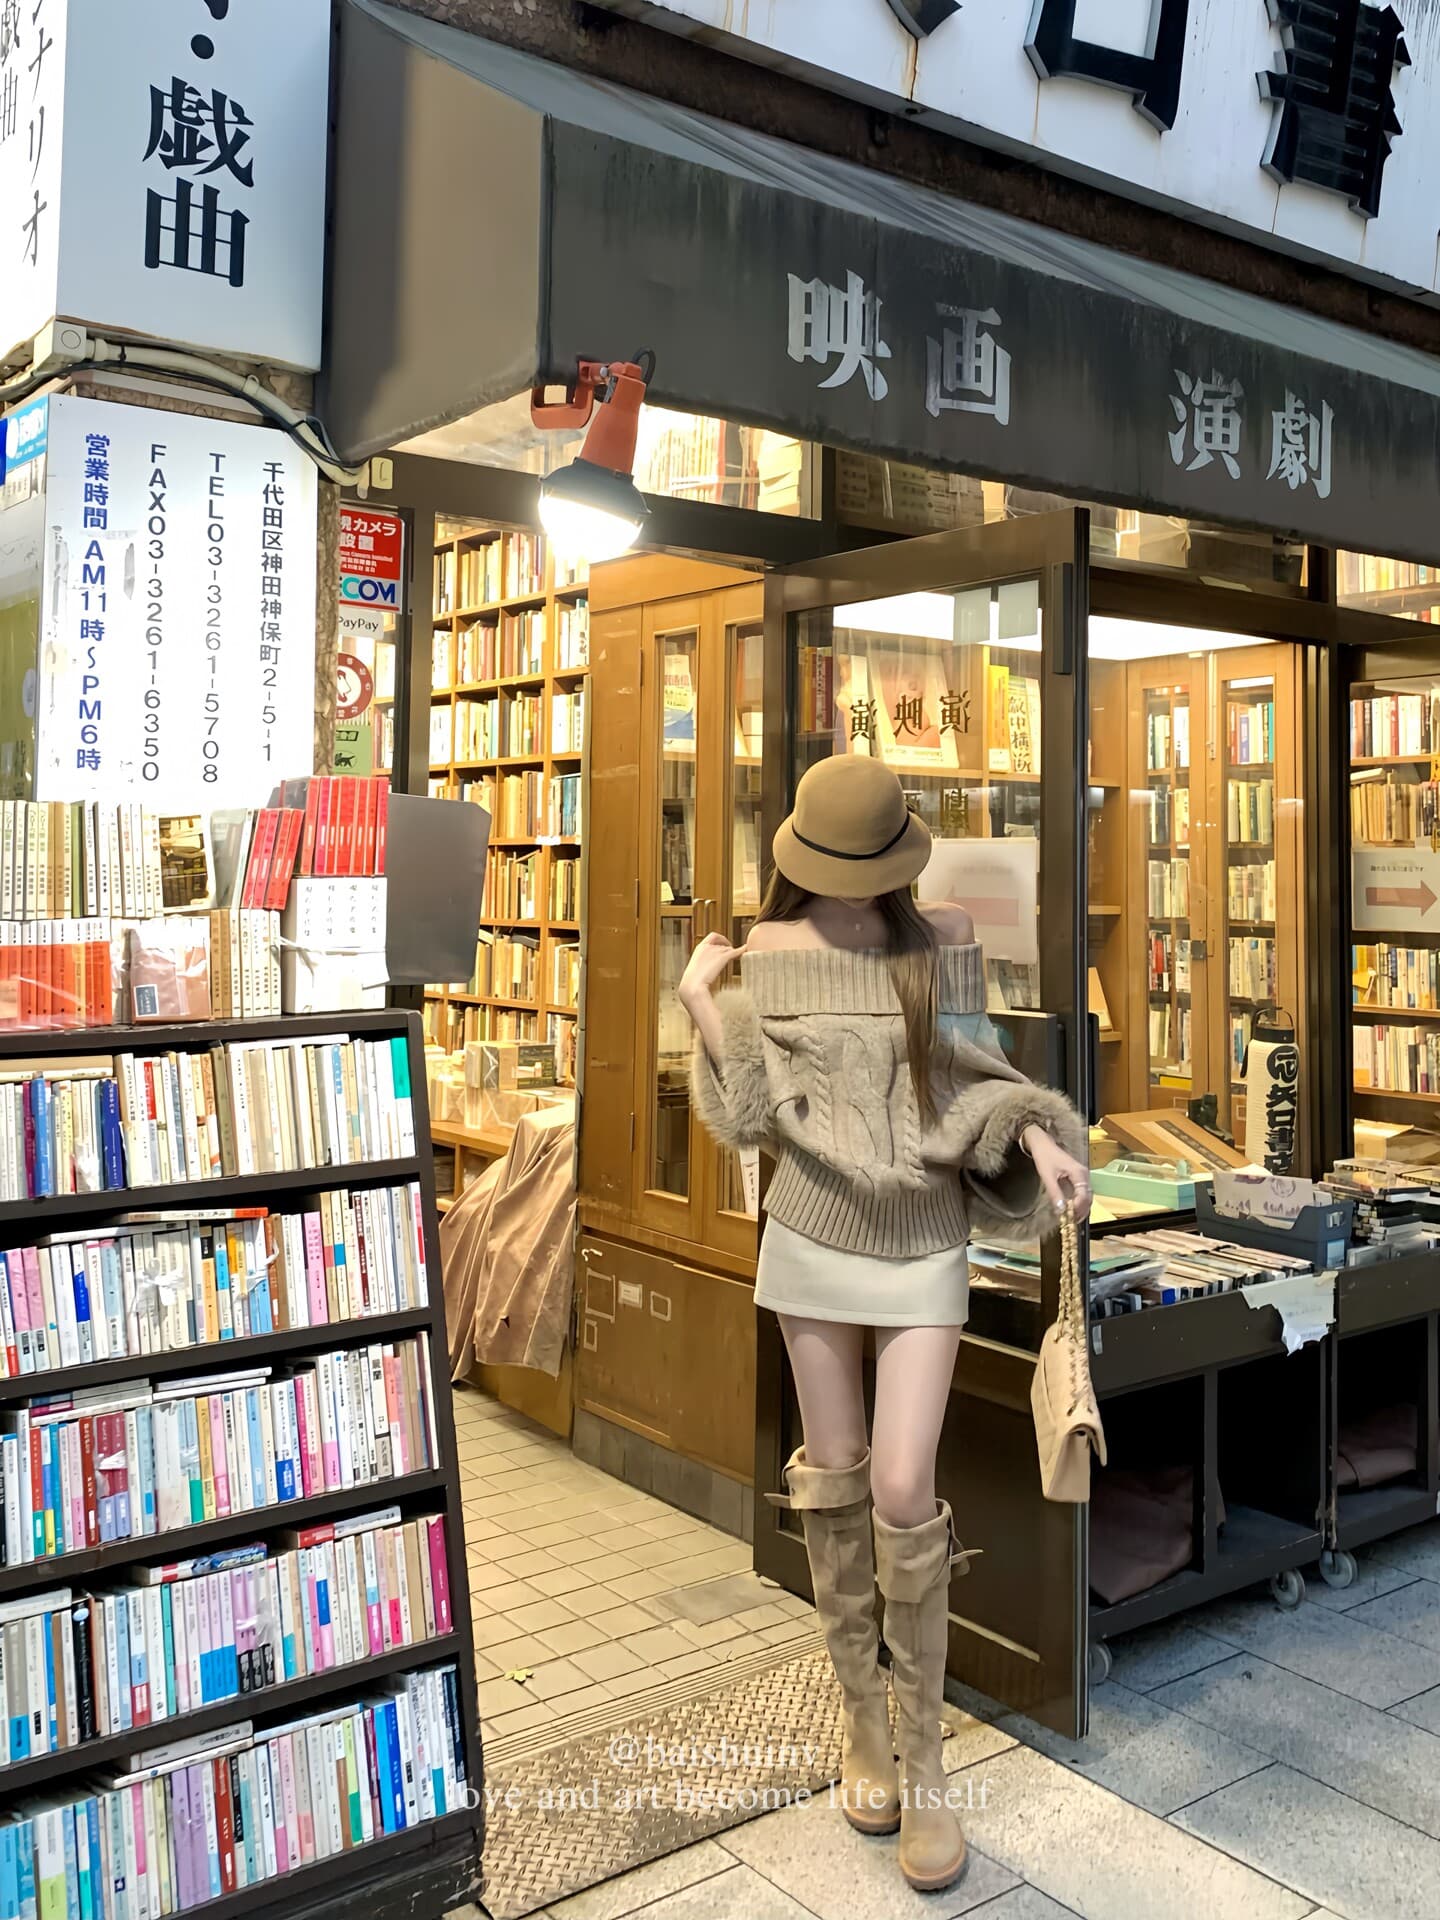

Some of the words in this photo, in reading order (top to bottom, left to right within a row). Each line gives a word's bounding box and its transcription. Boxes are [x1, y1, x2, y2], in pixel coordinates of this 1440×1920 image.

[142, 0, 255, 288] ・戯曲
[84, 433, 111, 531] 営業時間
[786, 269, 1012, 427] 映画
[1168, 367, 1335, 500] 演劇
[259, 461, 286, 763] 千代田区神田神保町2-5-1
